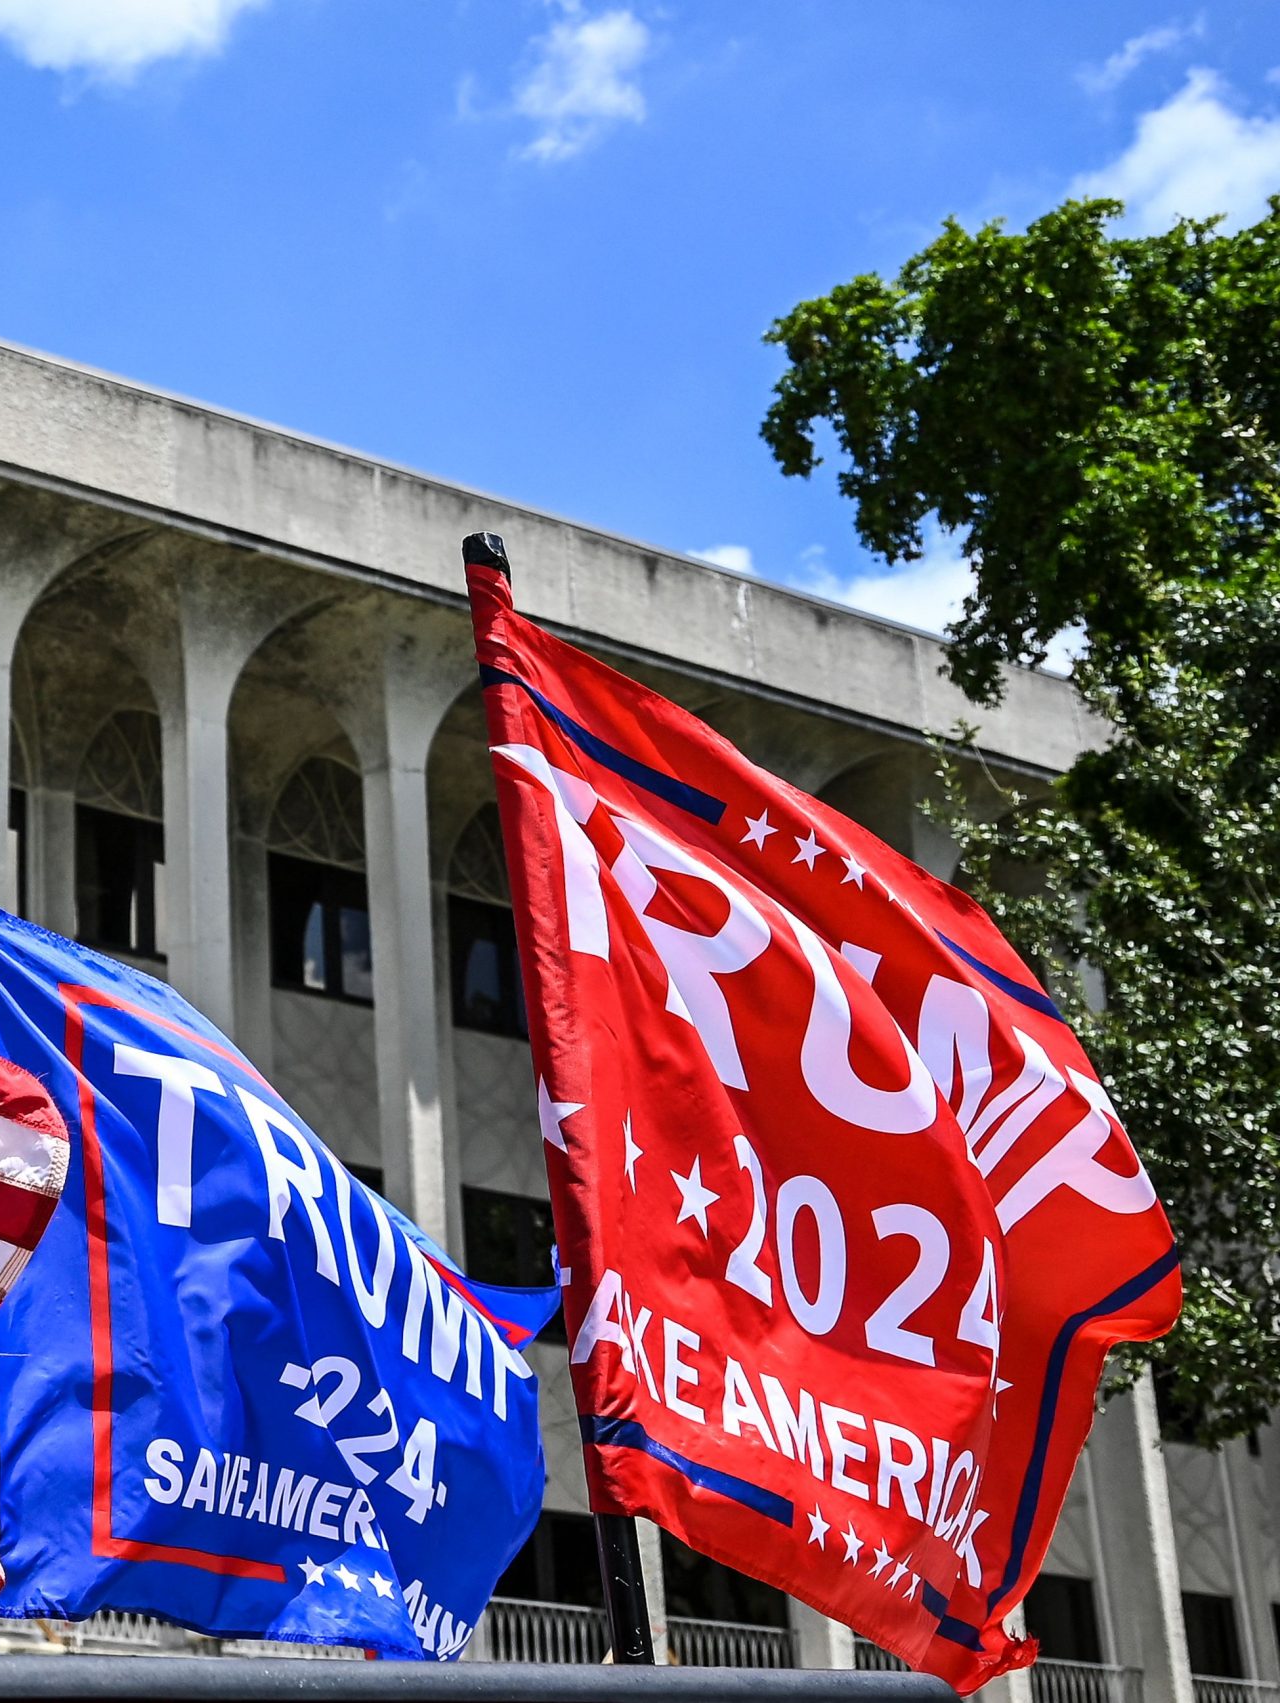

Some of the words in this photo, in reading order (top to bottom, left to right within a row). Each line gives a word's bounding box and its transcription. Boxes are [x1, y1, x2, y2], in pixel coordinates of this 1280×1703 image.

[489, 743, 1157, 1235] TRUMP
[562, 1267, 707, 1425] AKE
[725, 1135, 1001, 1389] 2024
[144, 1438, 251, 1518] SAVE
[246, 1462, 389, 1551] AMER
